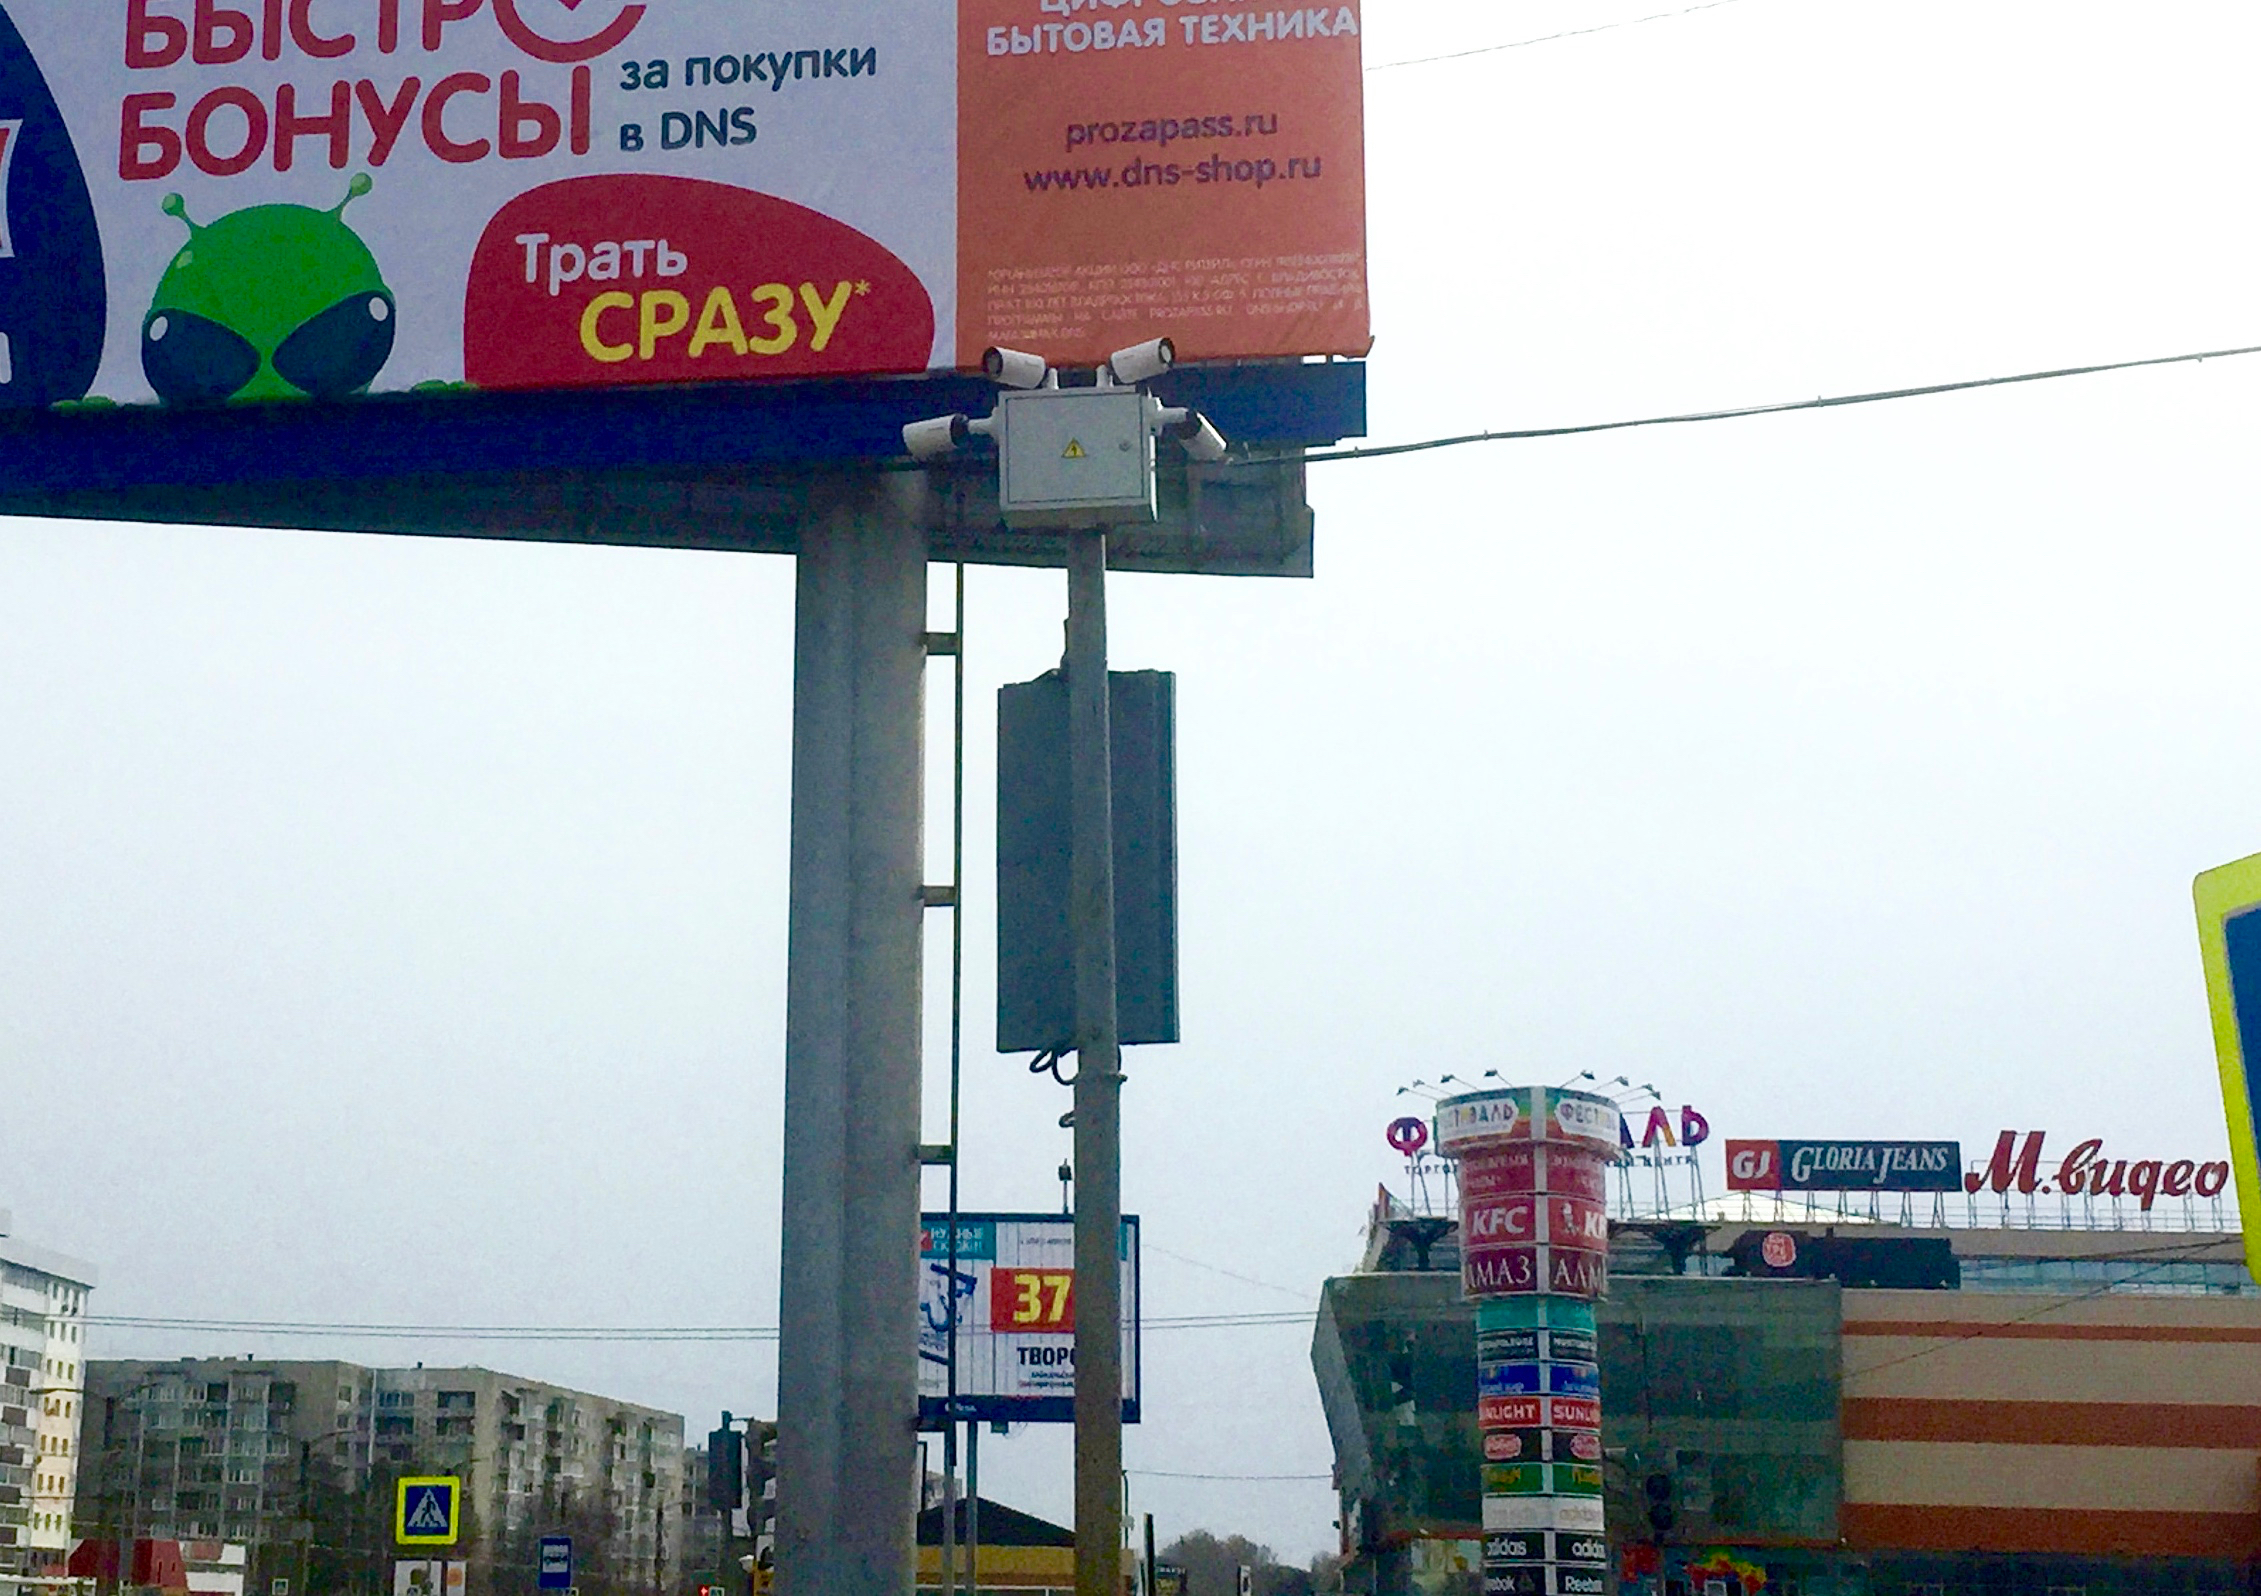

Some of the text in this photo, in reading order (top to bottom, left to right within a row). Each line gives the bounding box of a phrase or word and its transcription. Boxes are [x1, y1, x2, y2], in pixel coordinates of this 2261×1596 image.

[987, 18, 1166, 56] БЫТОВАЯ
[1179, 7, 1359, 45] ТЕХНИКА
[620, 46, 876, 90] за покупки
[119, 65, 590, 180] БОНУСЫ
[620, 106, 757, 151] в DNS
[1066, 113, 1278, 152] prozapass.ru
[1024, 154, 1322, 190] www.dns-shop.ru
[516, 233, 687, 295] Трать
[1733, 1147, 1949, 1184] GJ GLORIA JEANS
[1471, 1205, 1529, 1237] KFC
[1013, 1273, 1073, 1323] 37
[1483, 1403, 1536, 1421] NLIGHT
